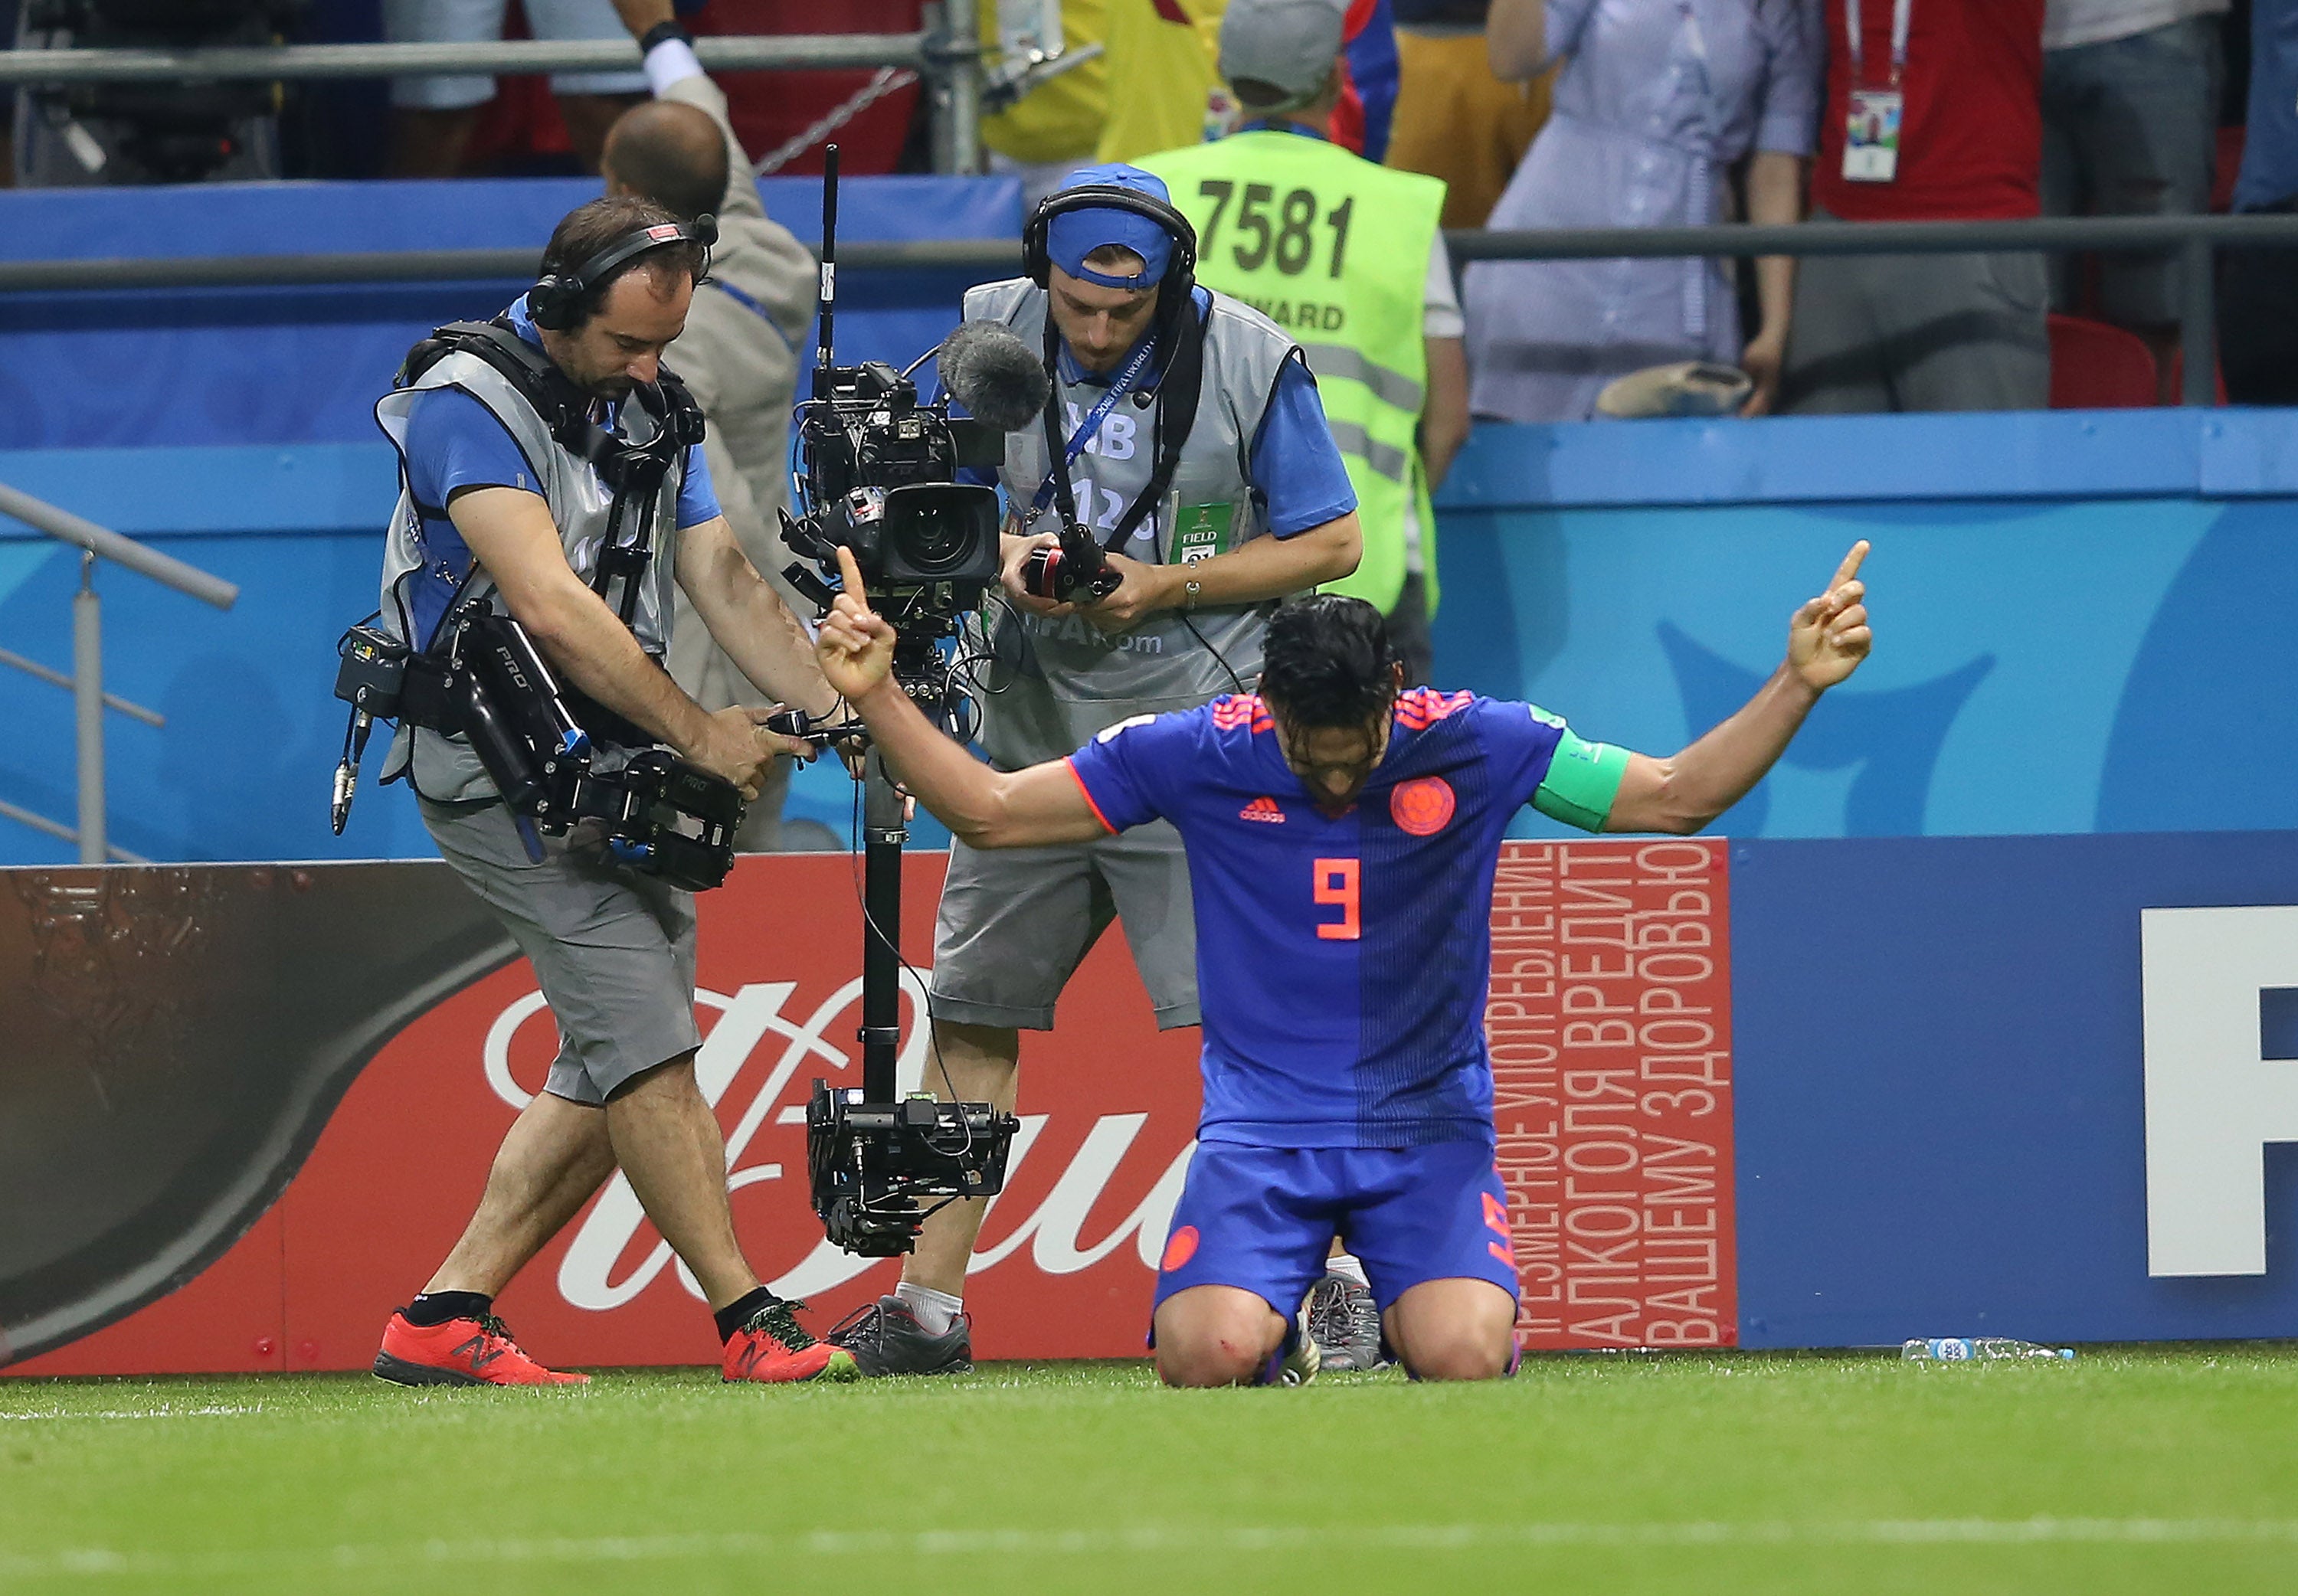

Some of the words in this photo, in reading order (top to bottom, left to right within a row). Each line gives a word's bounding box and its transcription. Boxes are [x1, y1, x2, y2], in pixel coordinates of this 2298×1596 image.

[1197, 181, 1353, 278] 7581
[1111, 378, 1130, 397] FIFA
[1182, 531, 1218, 544] FIELD
[496, 646, 529, 689] PRO
[1239, 809, 1287, 824] adidas
[1313, 858, 1361, 940] 9
[1560, 844, 1641, 1049] ВРЕДИТ
[1635, 842, 1730, 1117] ЗДОРОВЬЮ
[1563, 1068, 1641, 1346] АЛКОГОЛЯ
[1641, 1132, 1719, 1345] ВАШЕМУ
